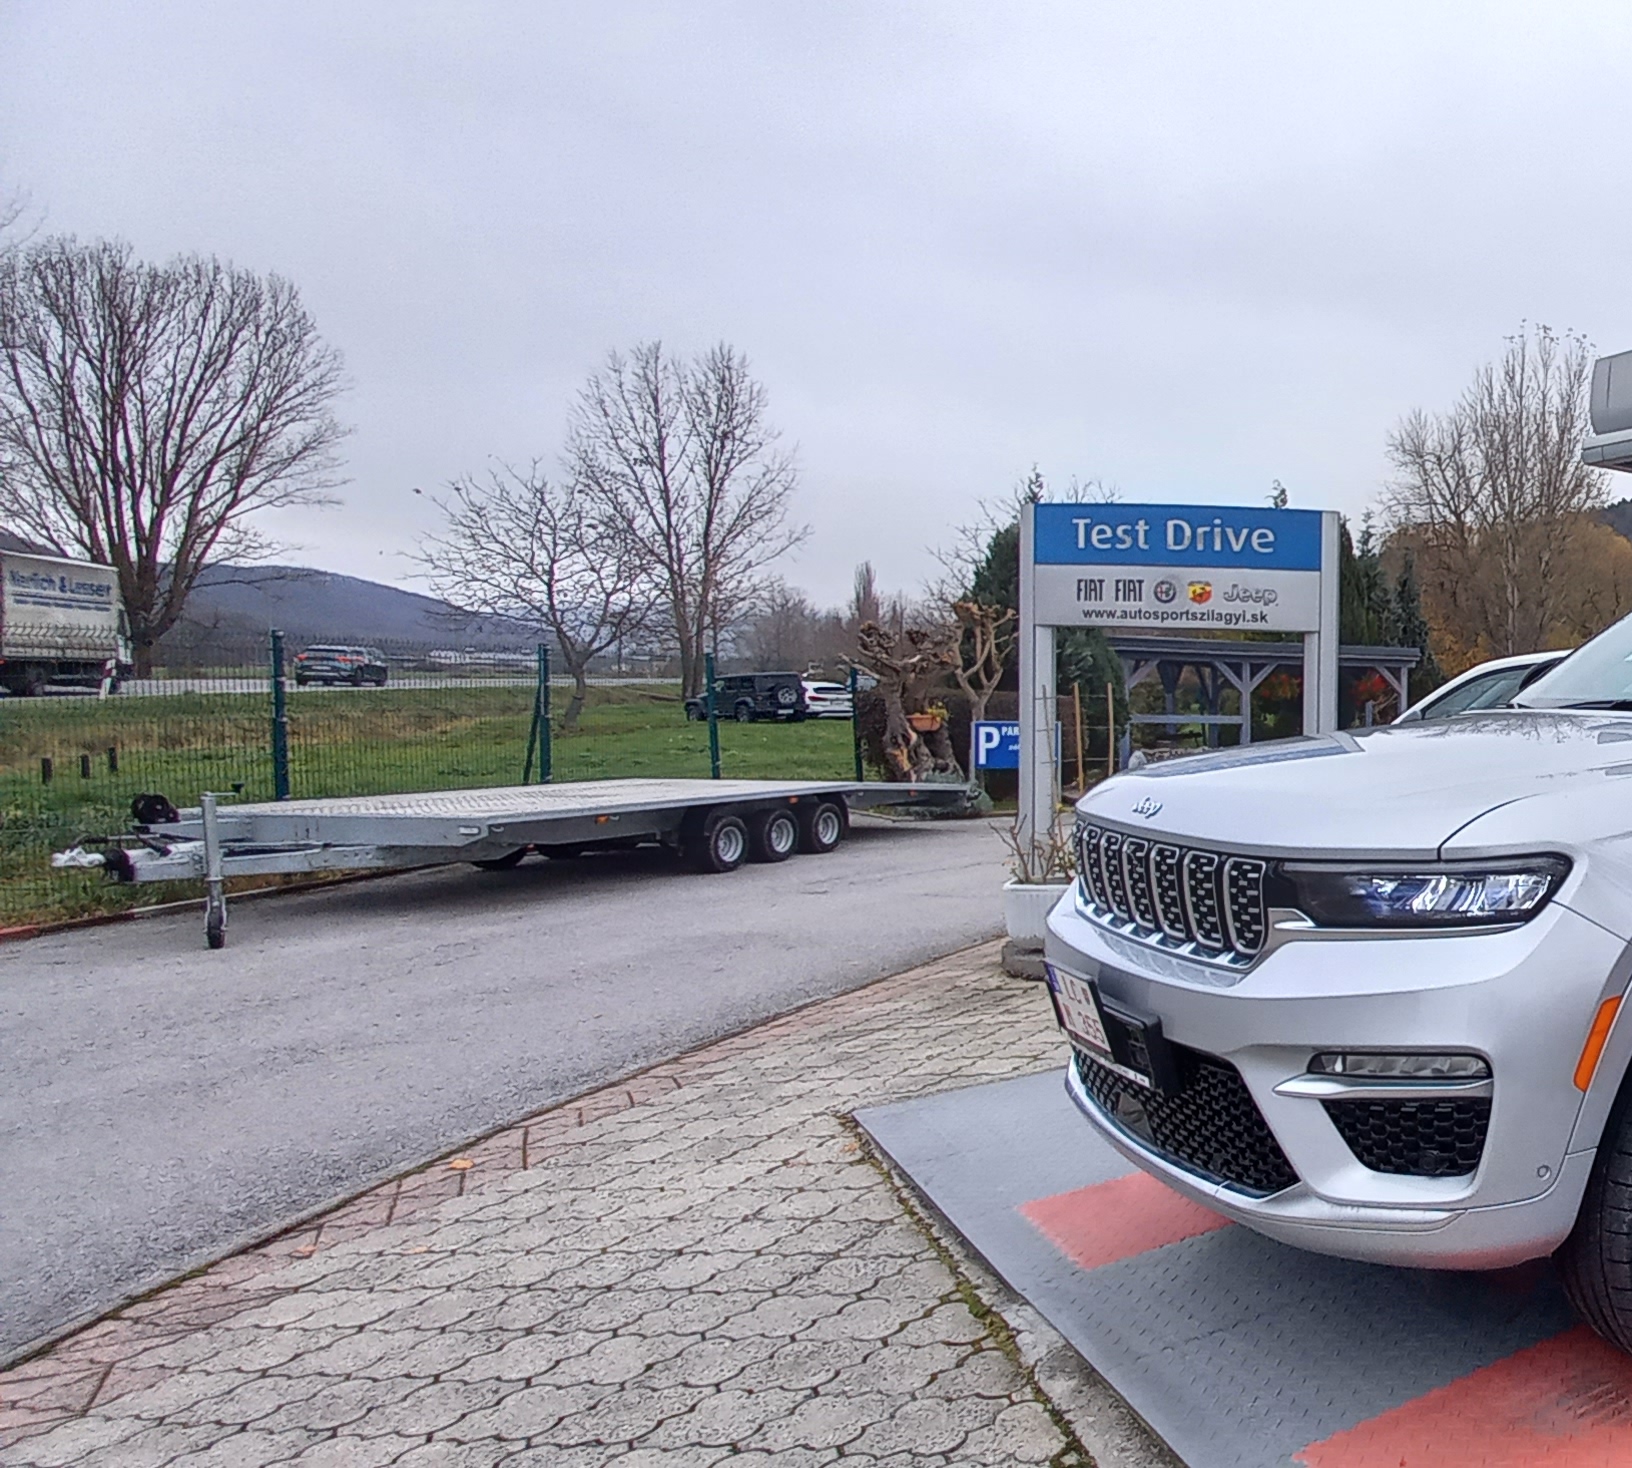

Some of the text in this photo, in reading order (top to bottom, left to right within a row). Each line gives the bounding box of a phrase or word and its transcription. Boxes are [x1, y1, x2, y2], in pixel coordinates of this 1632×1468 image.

[1071, 517, 1275, 553] Test Drive
[1076, 578, 1145, 602] FIAT FIAT
[1222, 583, 1279, 607] Jeep
[1081, 606, 1269, 626] www.autosportszilagyi.sk
[1001, 726, 1020, 737] PAR
[978, 726, 1001, 765] P
